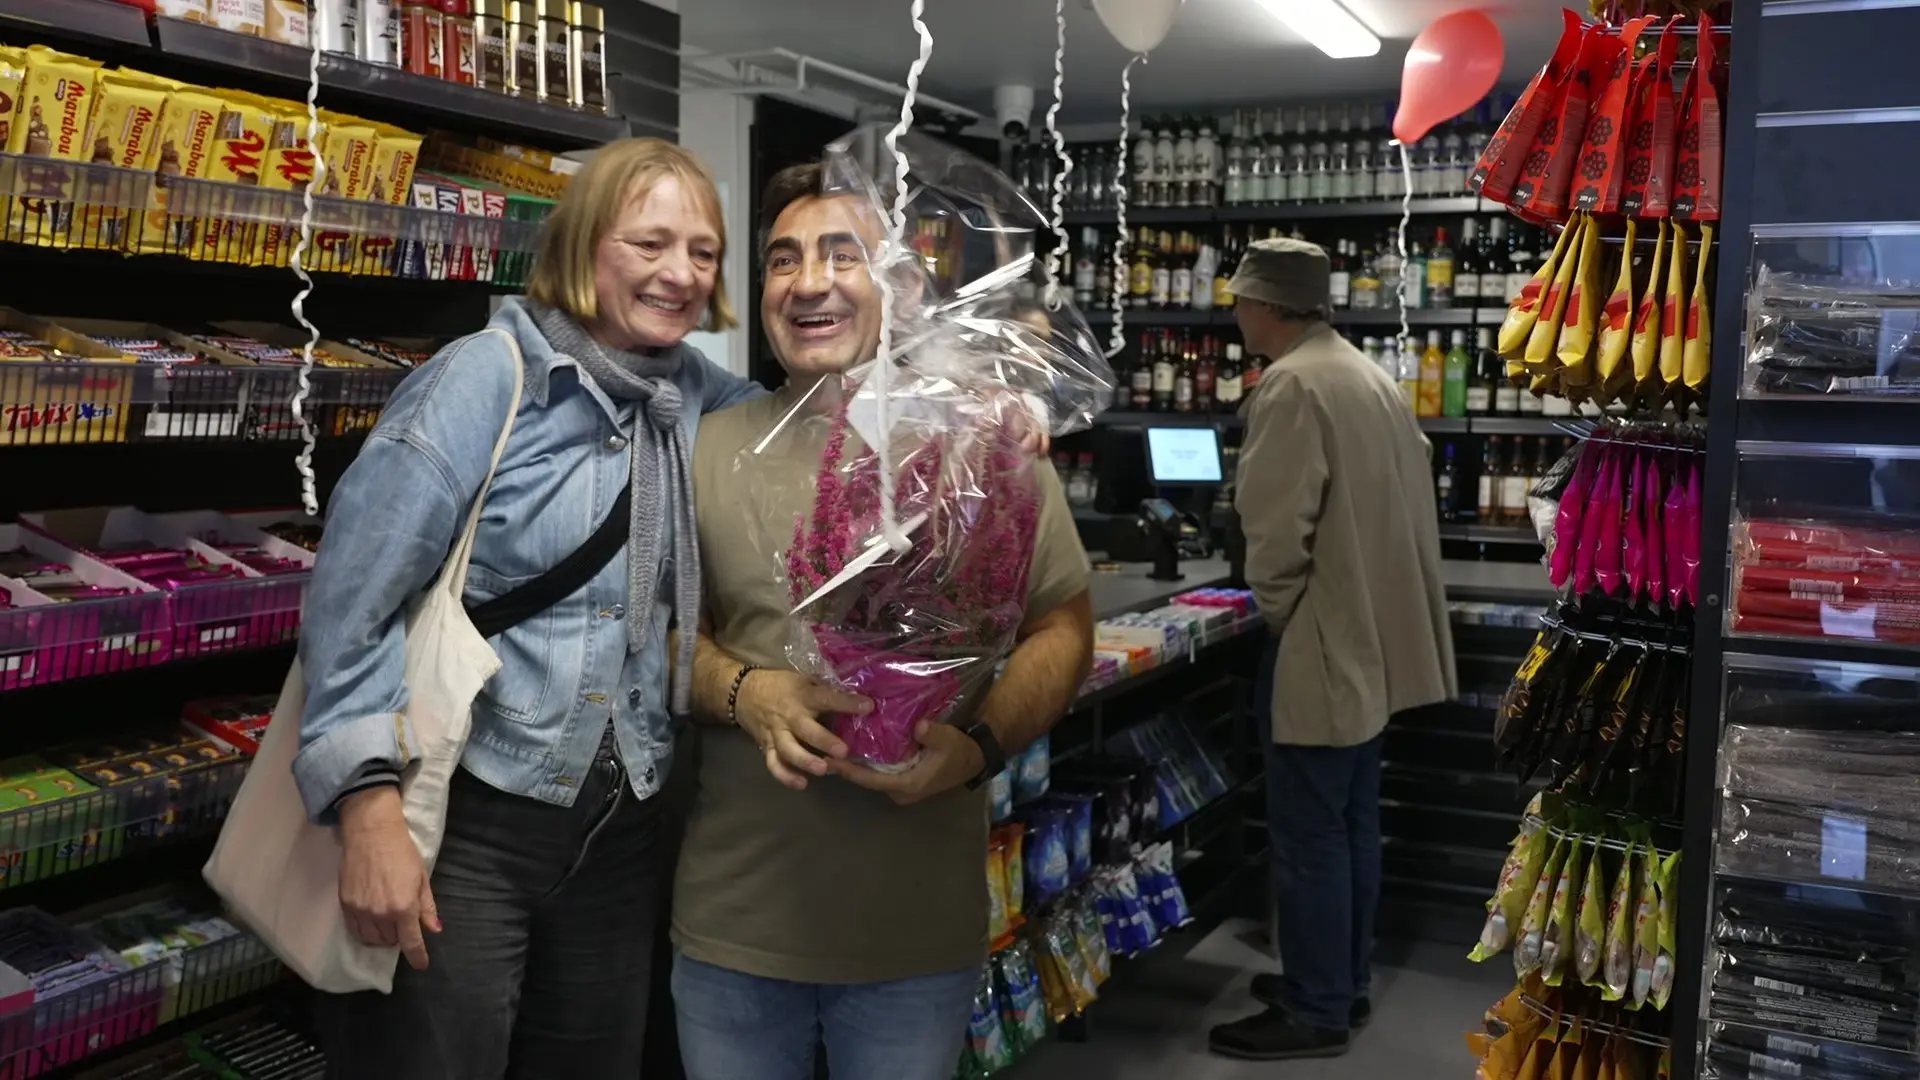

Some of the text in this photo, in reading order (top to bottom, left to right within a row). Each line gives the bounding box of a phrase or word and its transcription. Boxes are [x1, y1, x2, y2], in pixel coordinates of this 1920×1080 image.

[58, 80, 86, 155] Marabou
[185, 110, 214, 178] Marabou
[391, 151, 415, 205] Marabo
[4, 402, 73, 432] Twix
